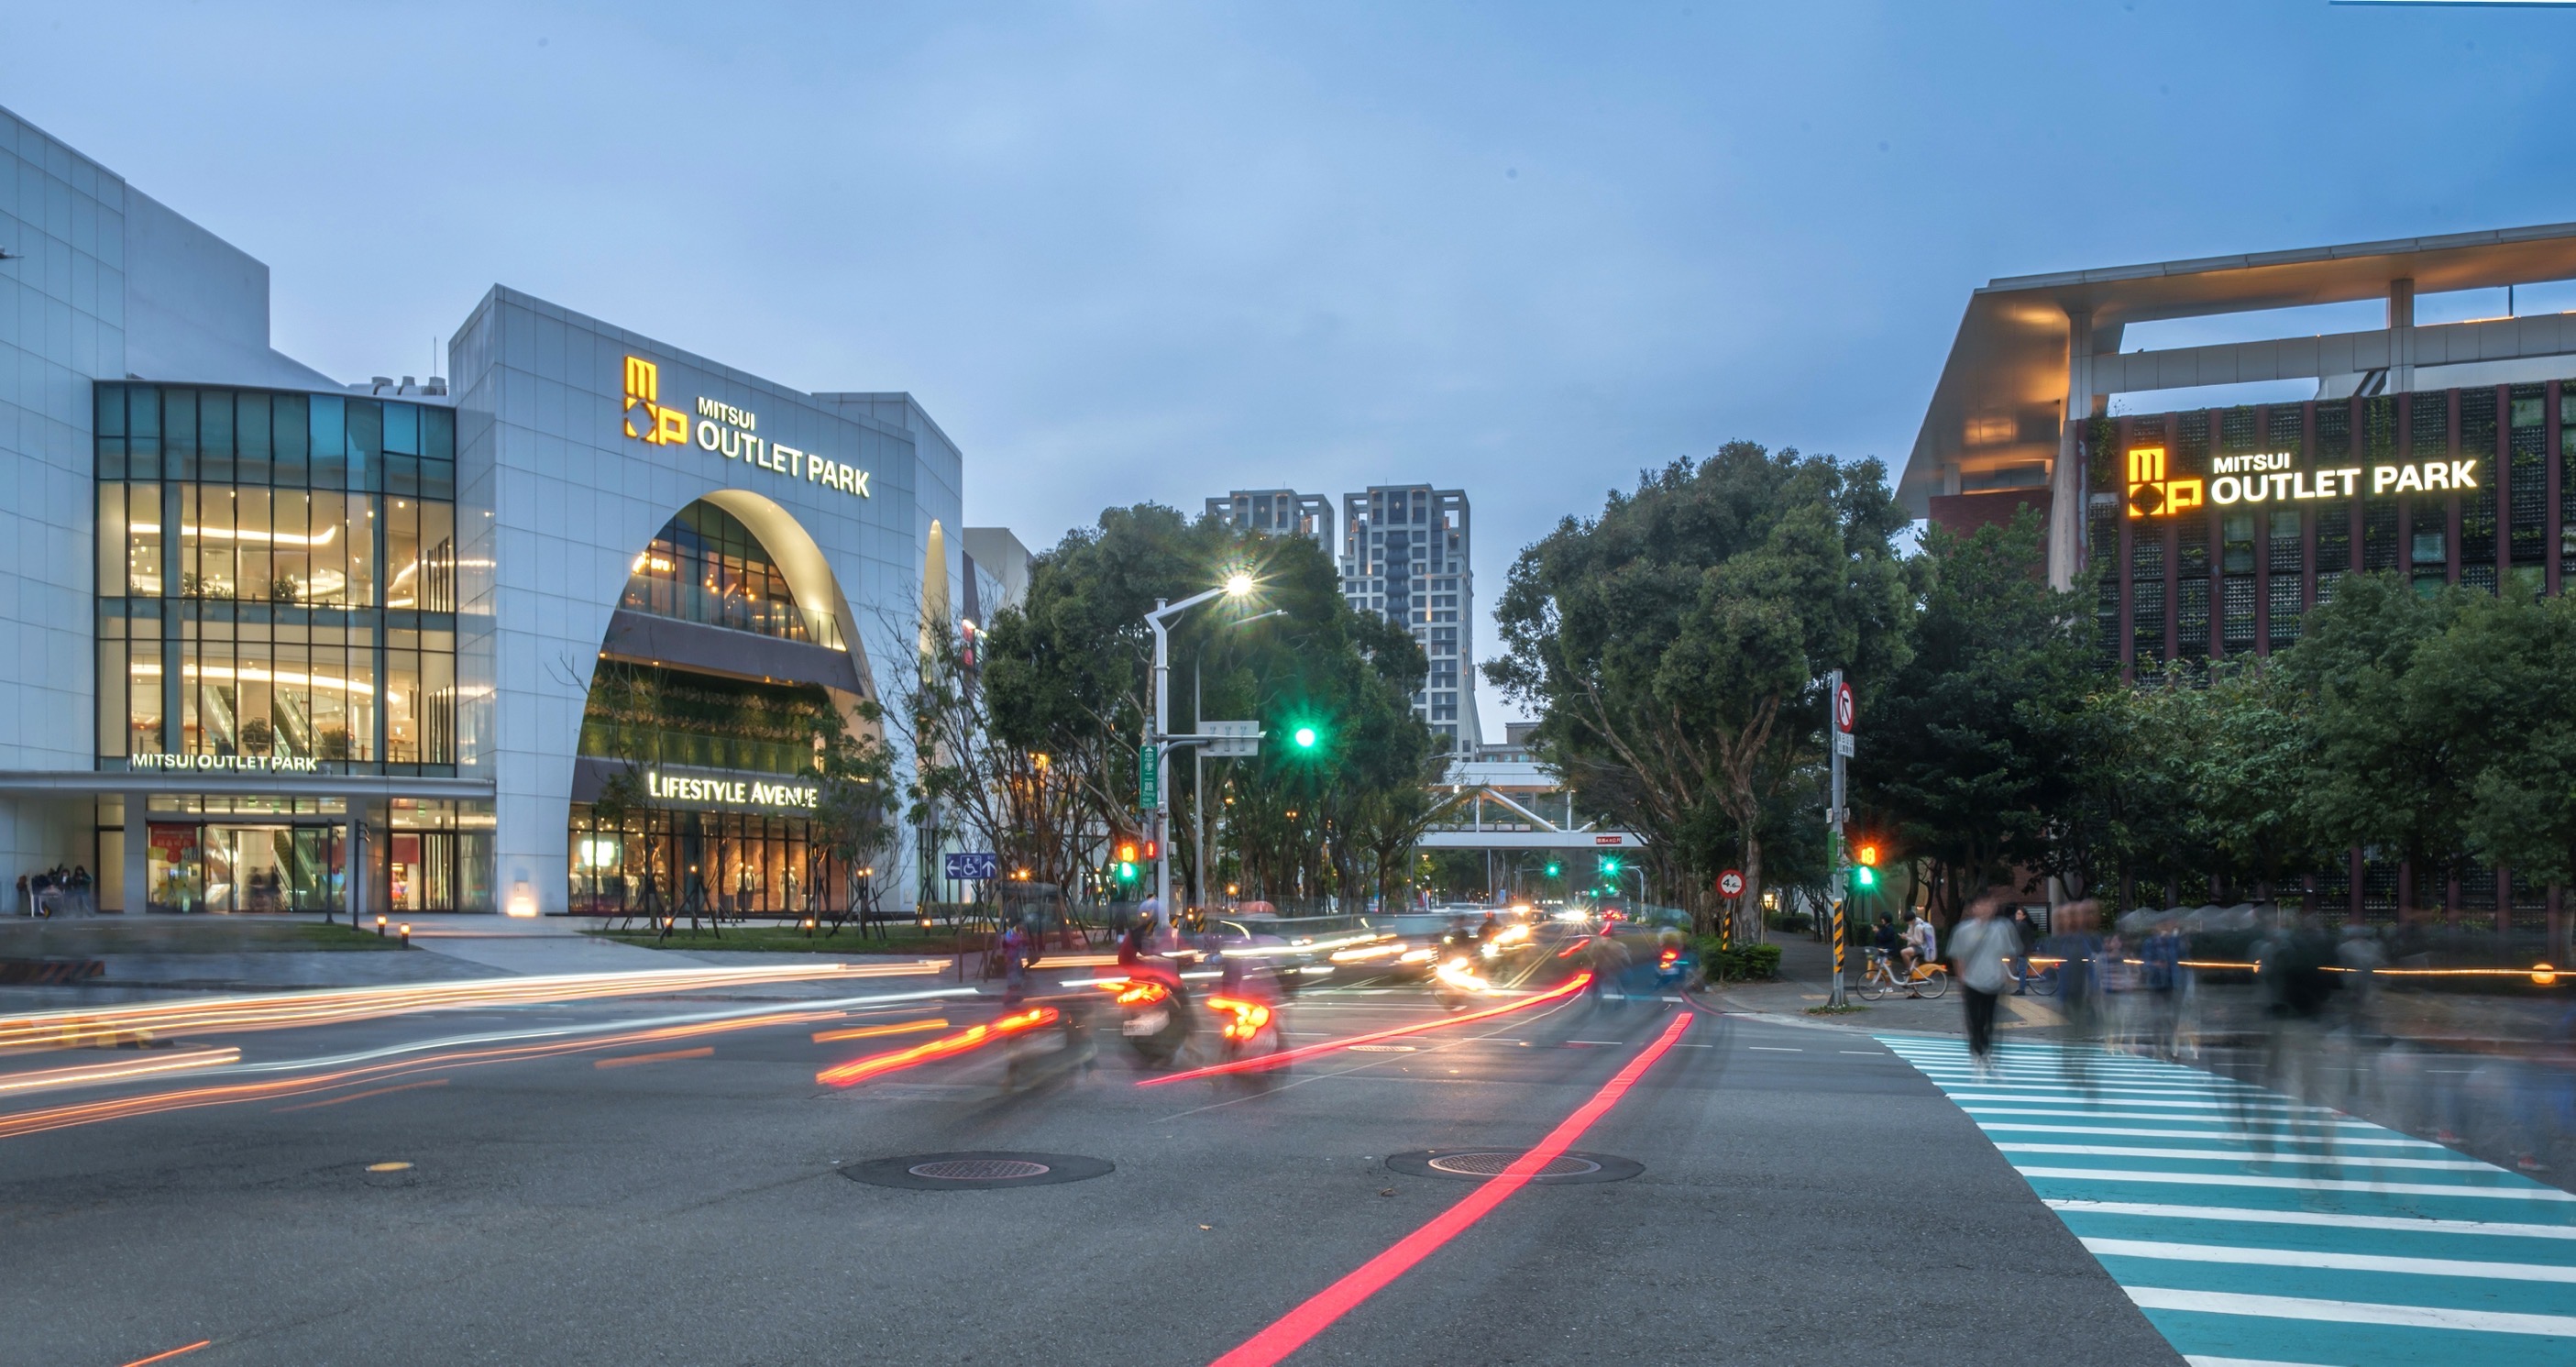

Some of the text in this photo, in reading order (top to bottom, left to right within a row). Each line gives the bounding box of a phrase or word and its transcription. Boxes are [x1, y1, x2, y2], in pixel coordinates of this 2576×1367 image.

[697, 396, 755, 431] MITSUI
[697, 420, 870, 498] OUTLET PARK
[2213, 453, 2290, 474] MITSUI
[2210, 459, 2477, 505] OUTLET PARK
[132, 754, 317, 771] MITSUI OUTLET PARK
[1144, 752, 1154, 791] 忠孝二路
[649, 772, 818, 808] LIFESTYLE AVENUE
[1861, 847, 1876, 865] 18
